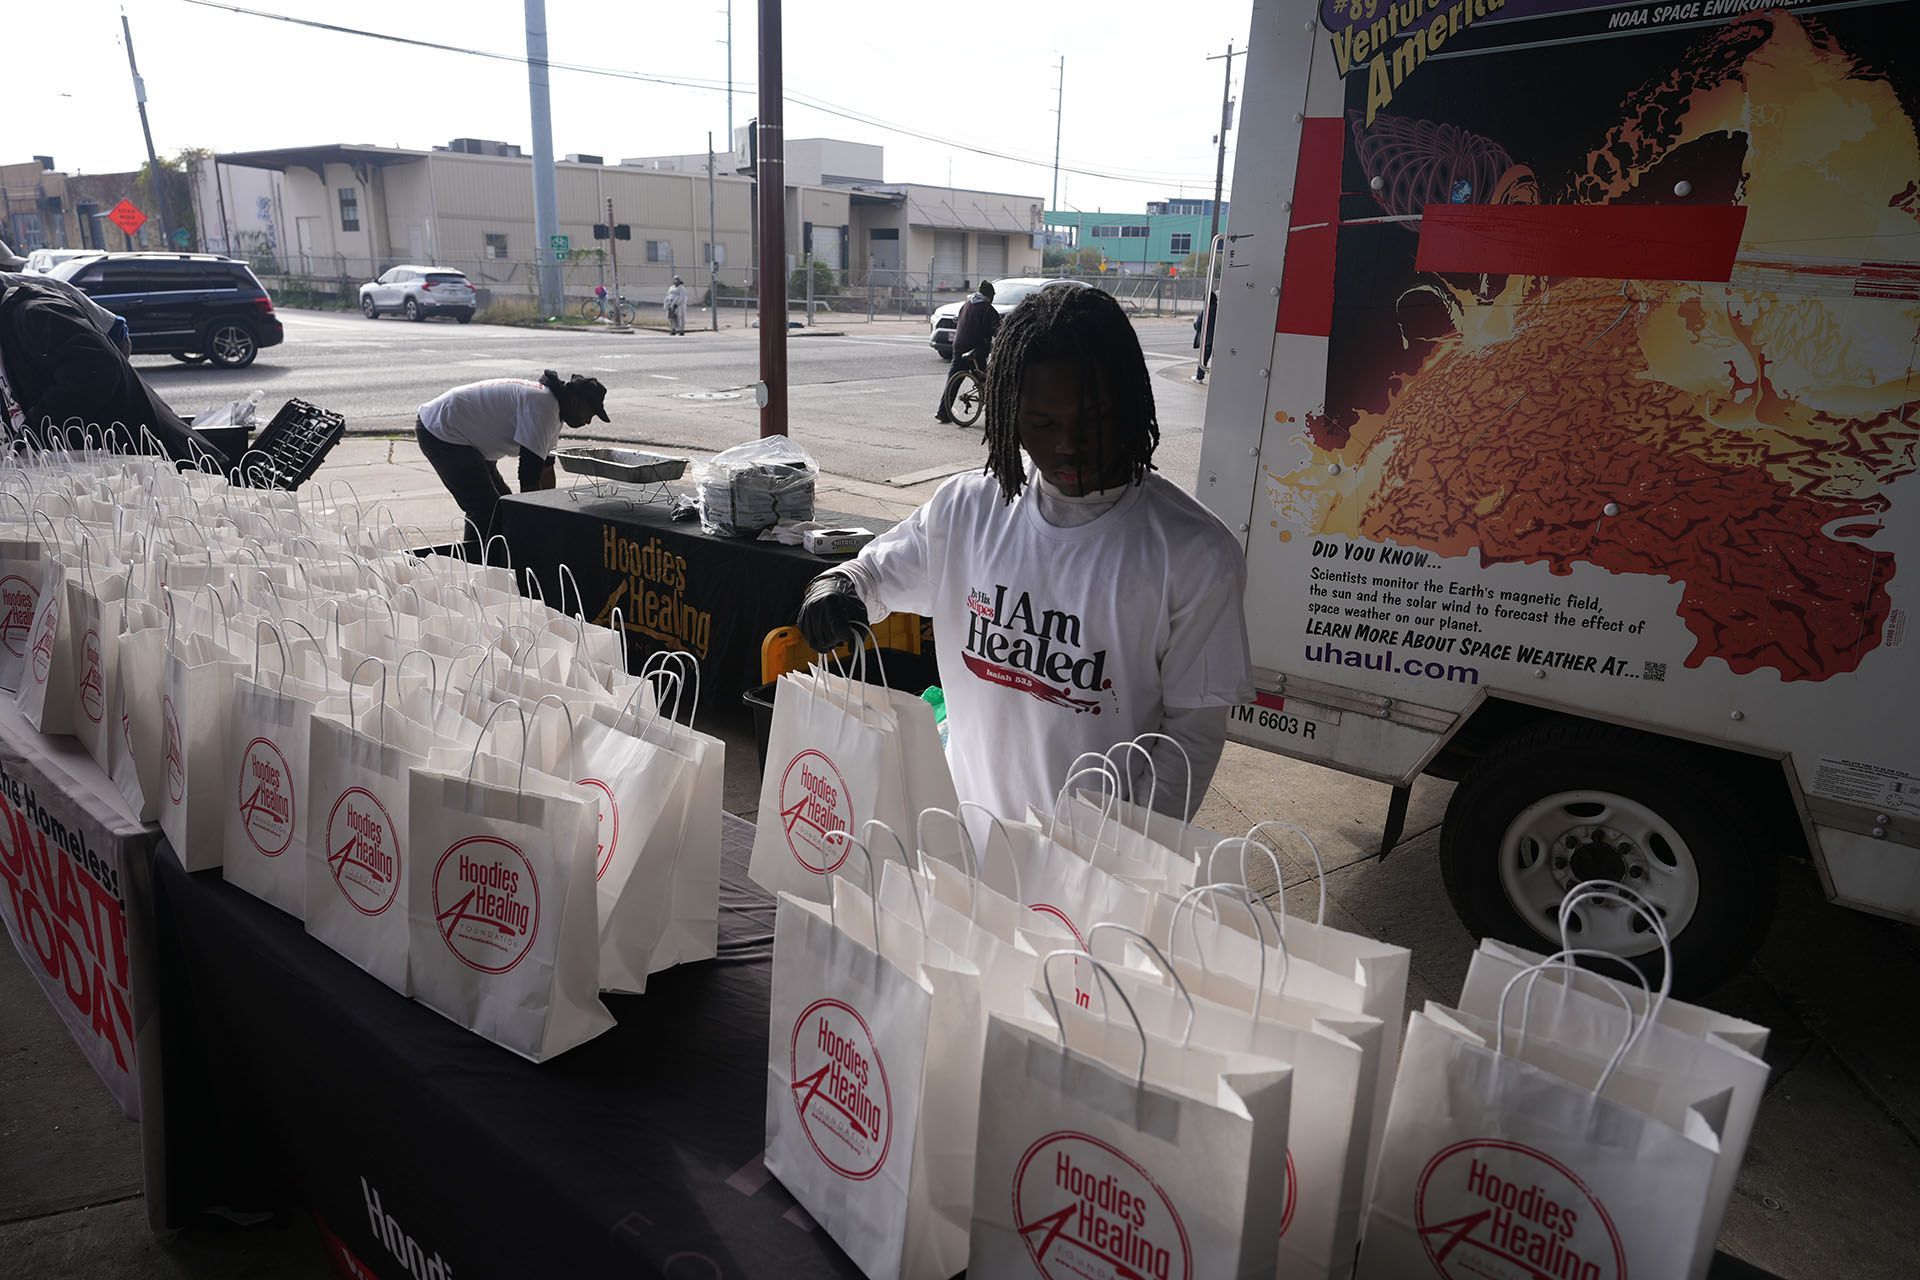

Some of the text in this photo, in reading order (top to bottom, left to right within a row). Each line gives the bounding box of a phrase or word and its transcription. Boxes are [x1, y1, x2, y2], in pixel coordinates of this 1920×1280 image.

[1608, 0, 1811, 29] NOAA SPACE ENVIRO
[603, 523, 687, 592] Hoodies
[3, 589, 32, 607] Hoodies
[1309, 584, 1646, 634] the sun and the solar wind to forecast the effect of
[1310, 567, 1602, 613] Scientists monitor the Earth's magnetic field,
[13, 606, 34, 626] Heali
[629, 574, 712, 661] Healing
[992, 585, 1080, 648] I Am
[1308, 602, 1482, 633] space weather on our planet.
[1305, 643, 1479, 685] uhaul.com
[1306, 618, 1351, 639] LEARN
[1355, 624, 1398, 646] MORE
[1402, 630, 1456, 653] ABOUT
[1460, 637, 1511, 660] SPACE
[1516, 645, 1597, 672] WEATHER
[1259, 711, 1298, 735] 6603
[1303, 721, 1317, 739] R
[0, 761, 21, 808] he
[252, 754, 280, 788] Hoodies
[801, 763, 836, 807] Hoodies
[260, 782, 288, 823] Healing
[347, 803, 382, 844] Hoodies
[808, 793, 845, 845] Healing
[356, 833, 392, 882] Healing
[460, 855, 518, 893] Hoodies
[476, 885, 529, 935] Healing
[818, 1017, 868, 1086] Hoodies
[829, 1060, 880, 1142] Healing
[1056, 1151, 1147, 1226] Hoodies
[1468, 1159, 1577, 1239] Hoodies
[1079, 1201, 1170, 1280] Healing
